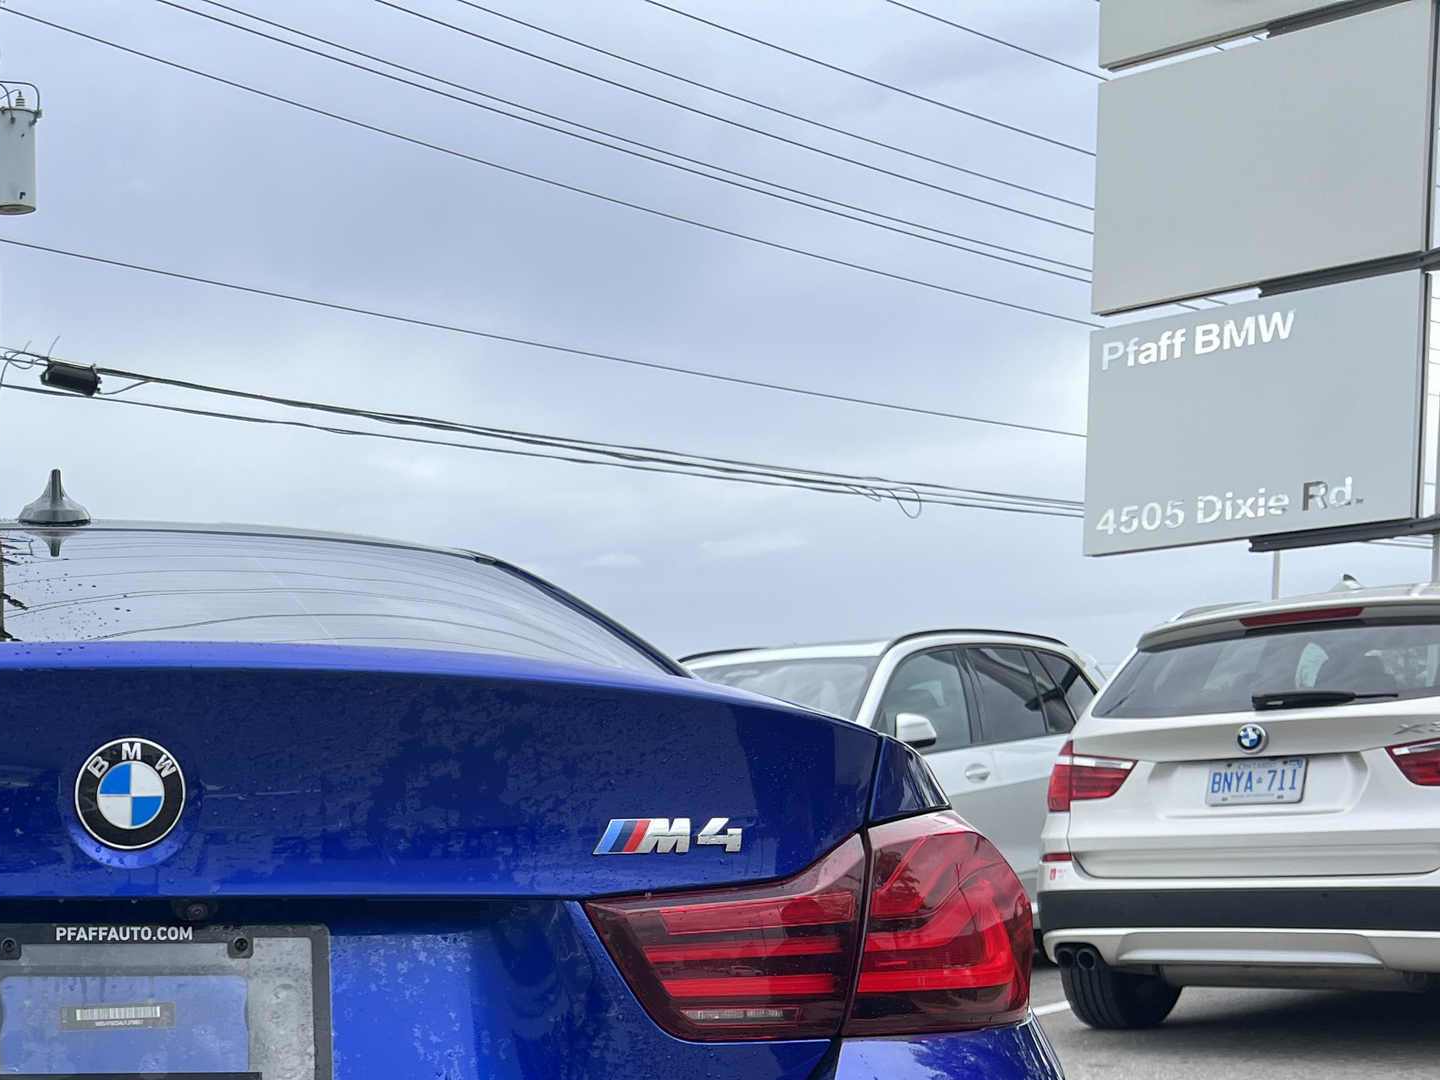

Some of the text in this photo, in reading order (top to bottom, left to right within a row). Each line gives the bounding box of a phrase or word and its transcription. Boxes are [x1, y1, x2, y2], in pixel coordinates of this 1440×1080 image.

[1101, 309, 1296, 371] Pfaff BMW
[1096, 476, 1364, 535] 4505 Dixie Rd.
[87, 742, 176, 778] BMW
[634, 817, 743, 853] M4
[55, 926, 193, 941] PFAFFAUTO.COM
